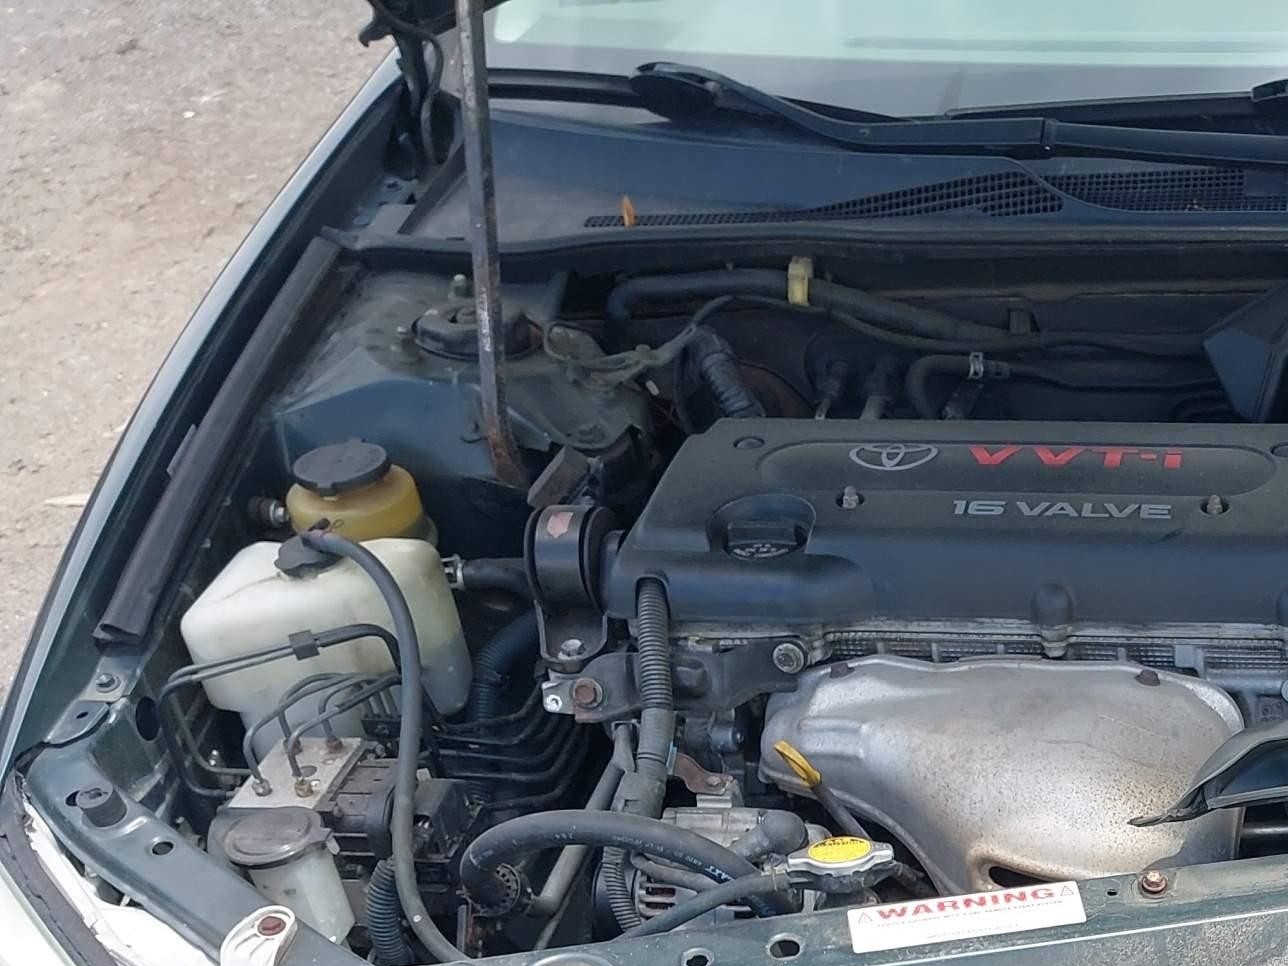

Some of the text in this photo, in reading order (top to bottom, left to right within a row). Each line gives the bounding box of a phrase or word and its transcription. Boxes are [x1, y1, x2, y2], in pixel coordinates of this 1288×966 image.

[953, 500, 1173, 520] 16 VALVE
[877, 888, 1055, 920] WARNING
